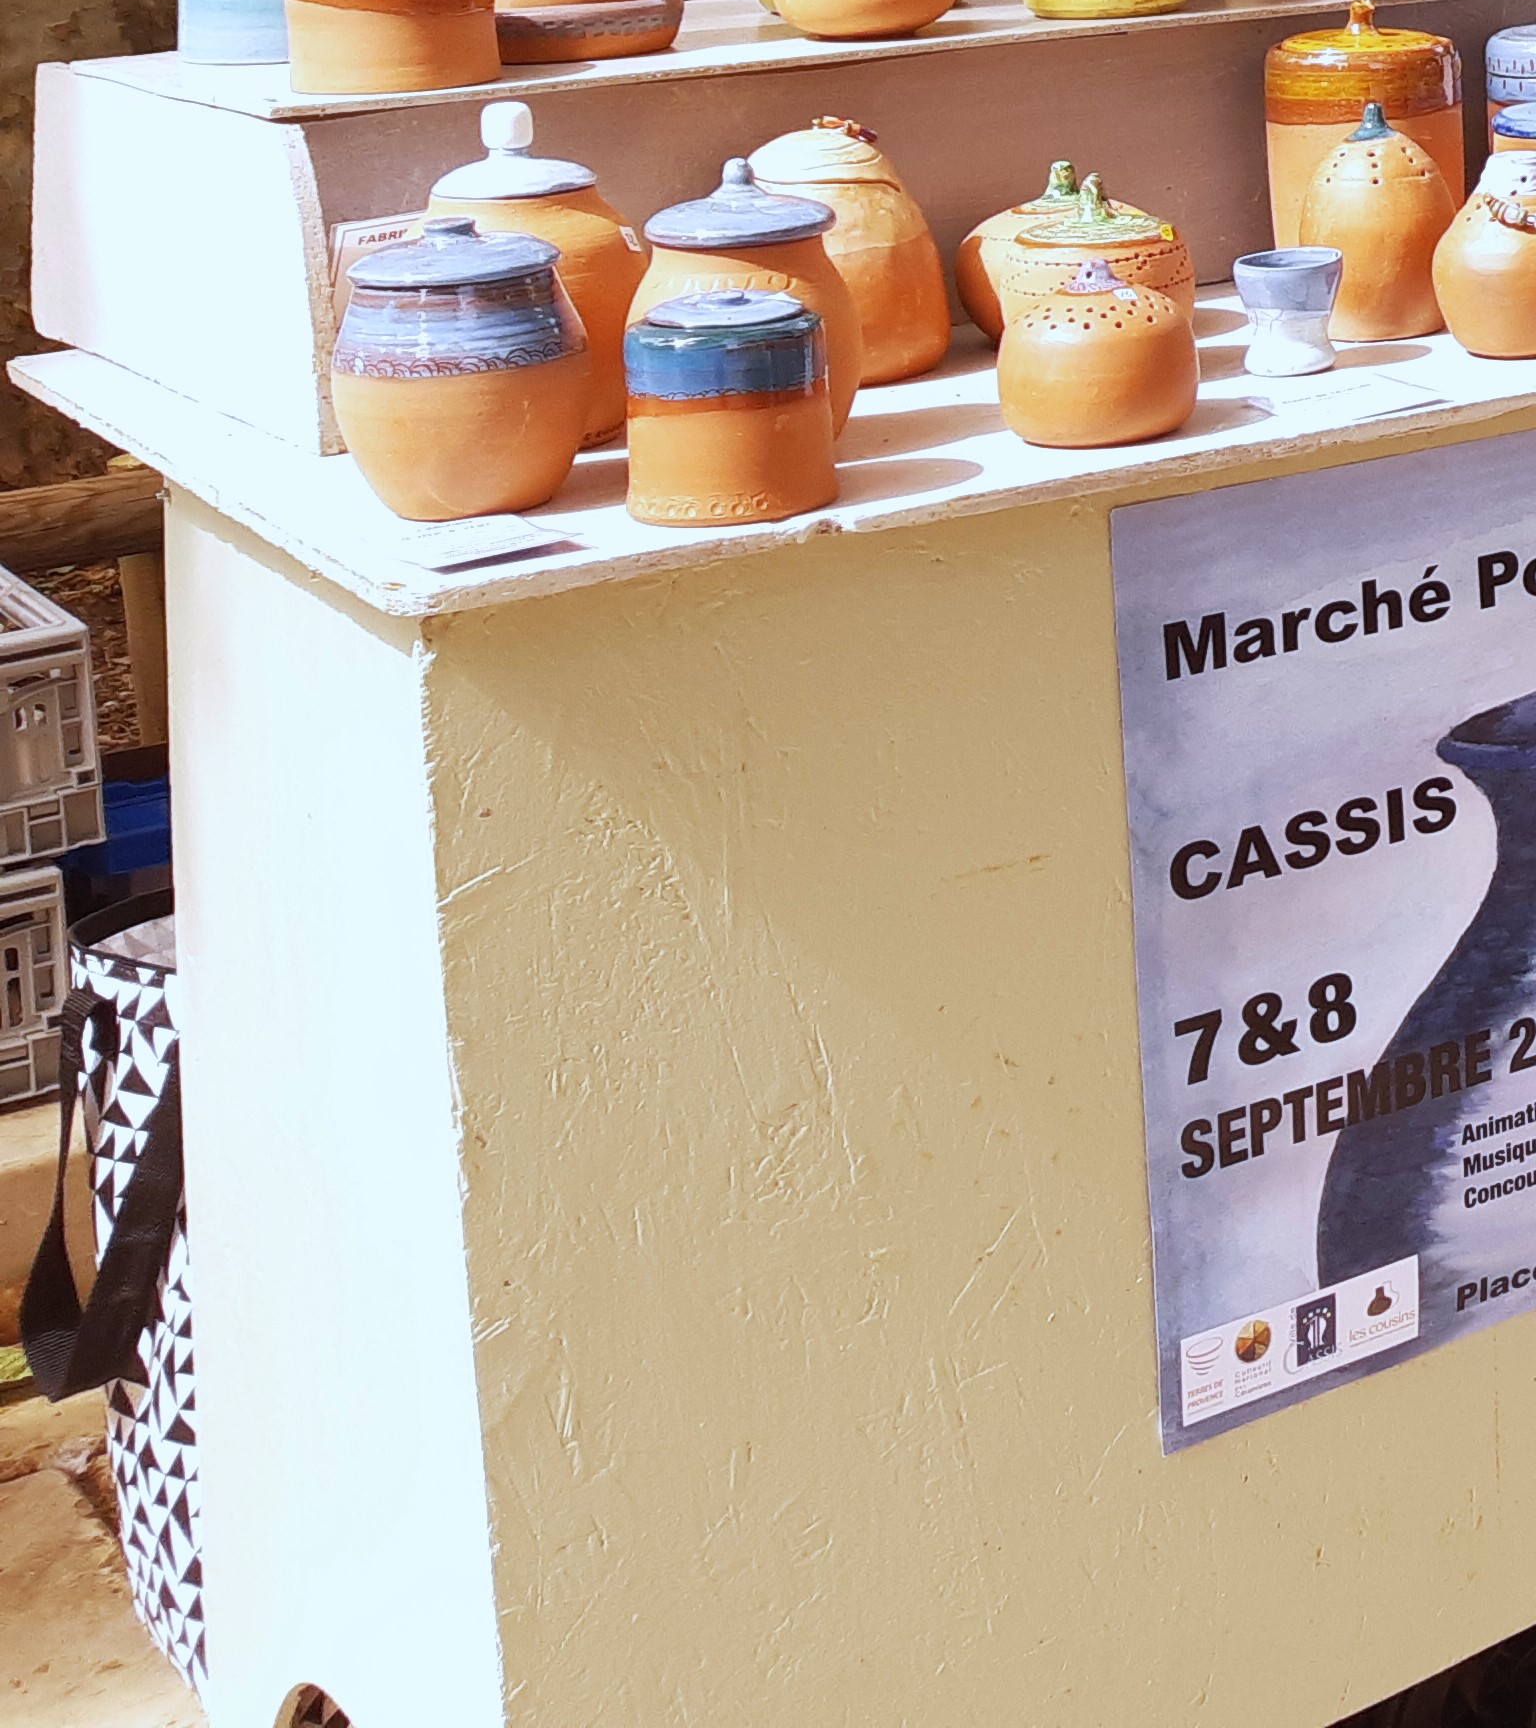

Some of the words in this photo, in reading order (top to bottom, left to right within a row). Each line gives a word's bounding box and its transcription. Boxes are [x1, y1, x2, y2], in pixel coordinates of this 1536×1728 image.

[1163, 565, 1451, 680] Marché
[1169, 777, 1457, 900] CASSIS
[1180, 1028, 1493, 1179] SEPTEMBRE
[1350, 1328, 1367, 1341] les
[1368, 1309, 1416, 1336] cousins
